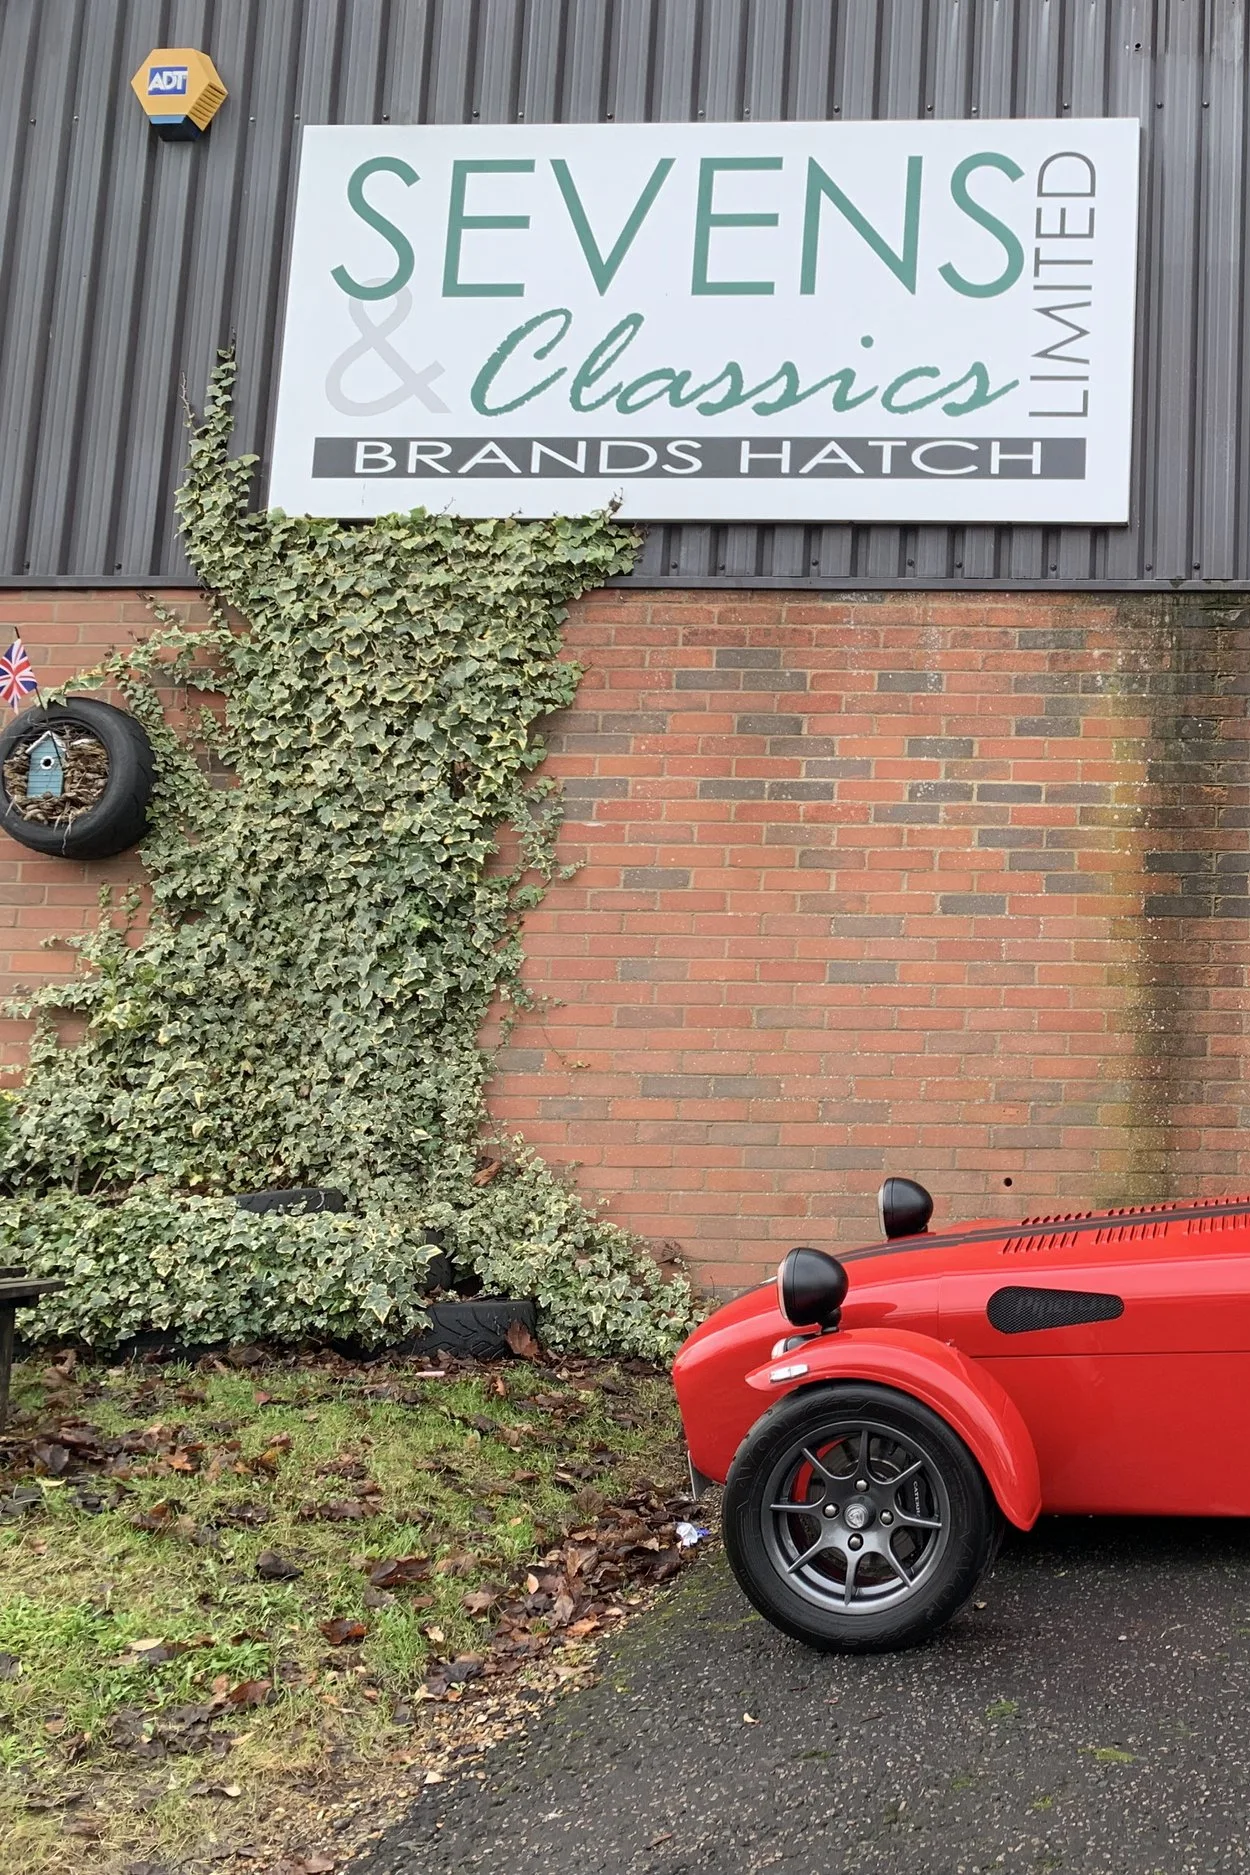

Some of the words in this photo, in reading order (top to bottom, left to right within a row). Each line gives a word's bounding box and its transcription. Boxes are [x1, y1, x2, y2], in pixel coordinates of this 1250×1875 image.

[148, 70, 188, 91] ADT
[331, 152, 1025, 301] SEVENS
[1028, 151, 1096, 418] LIMITED
[325, 277, 452, 417] &
[470, 308, 1019, 418] Classics
[354, 439, 702, 475] BRANDS
[740, 440, 1041, 475] HATCH
